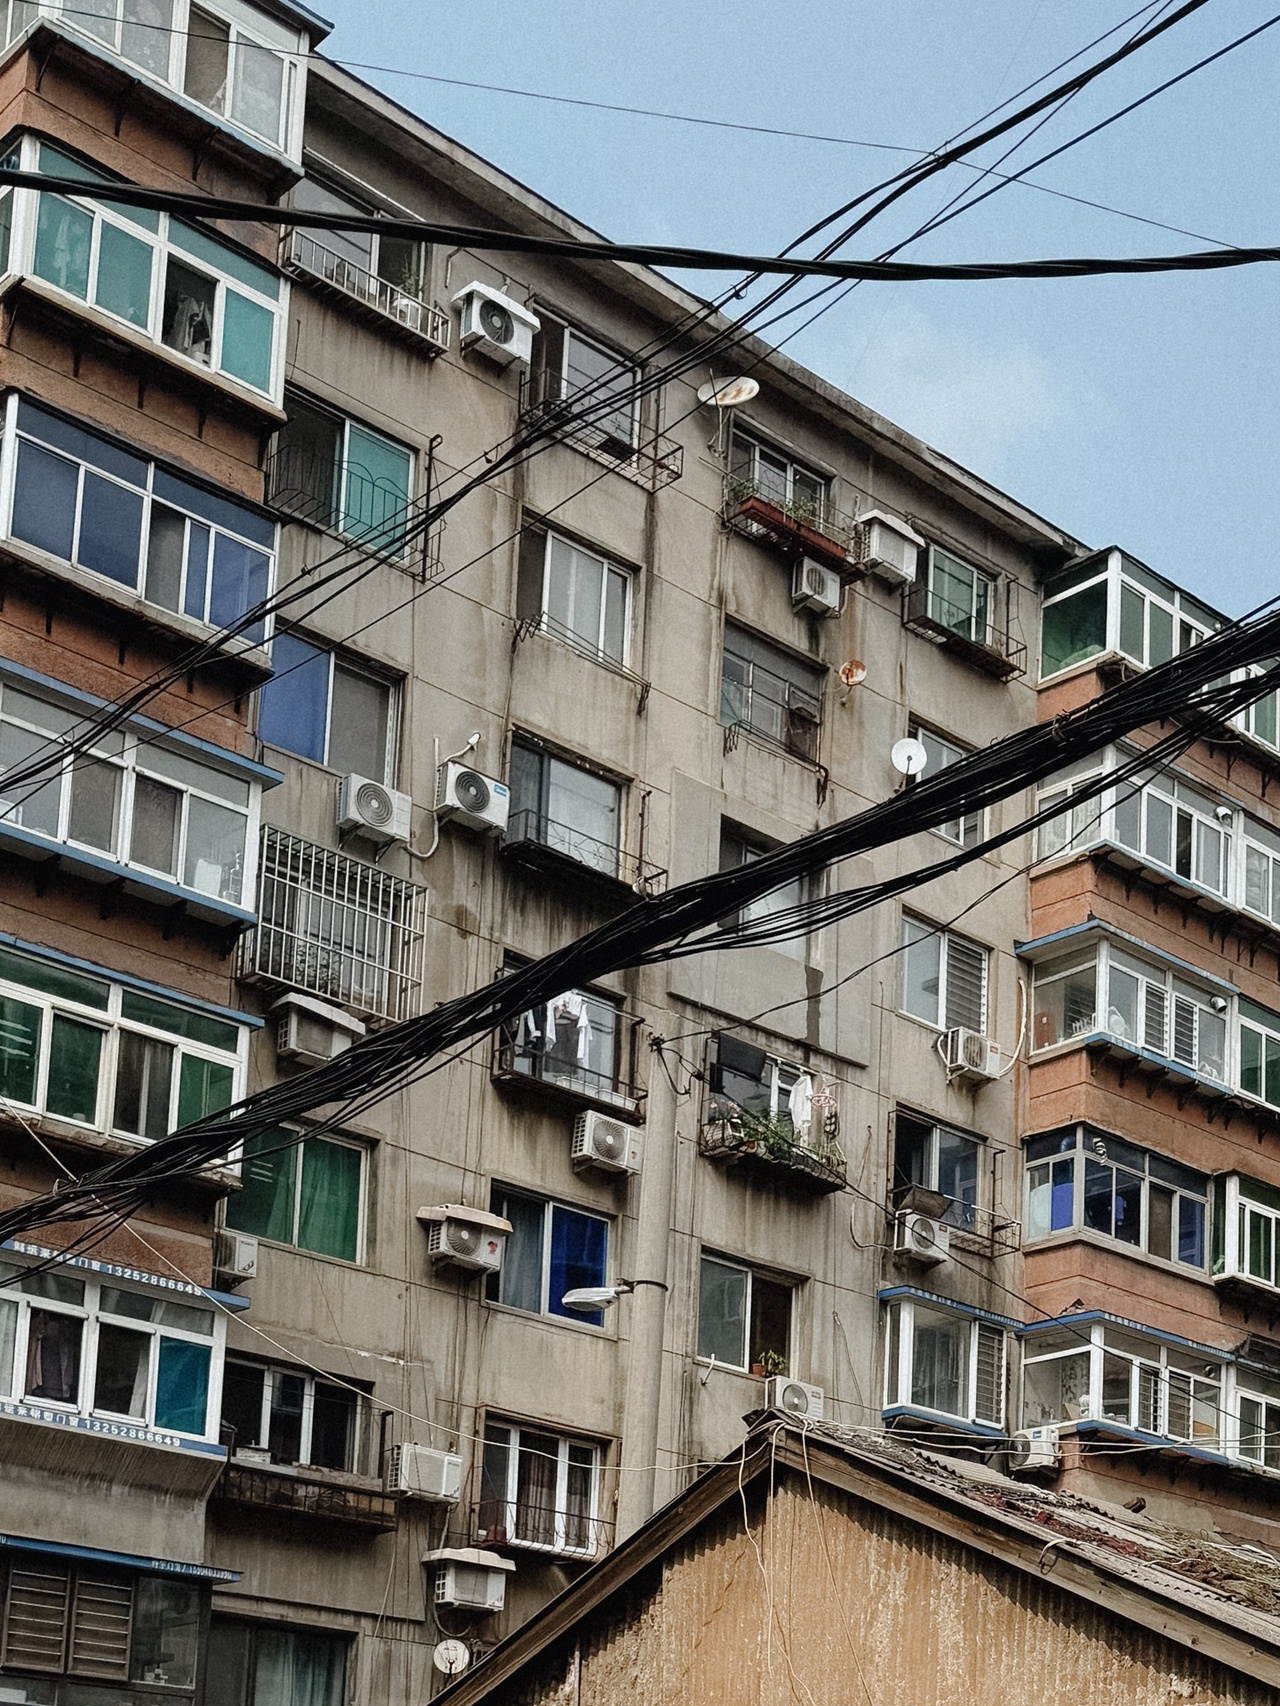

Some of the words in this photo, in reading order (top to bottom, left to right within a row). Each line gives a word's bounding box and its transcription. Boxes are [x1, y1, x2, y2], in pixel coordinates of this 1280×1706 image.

[107, 1264, 203, 1297] 13252866649
[0, 1402, 79, 1427] 运来铝塑门窗
[84, 1420, 180, 1447] 13252866649
